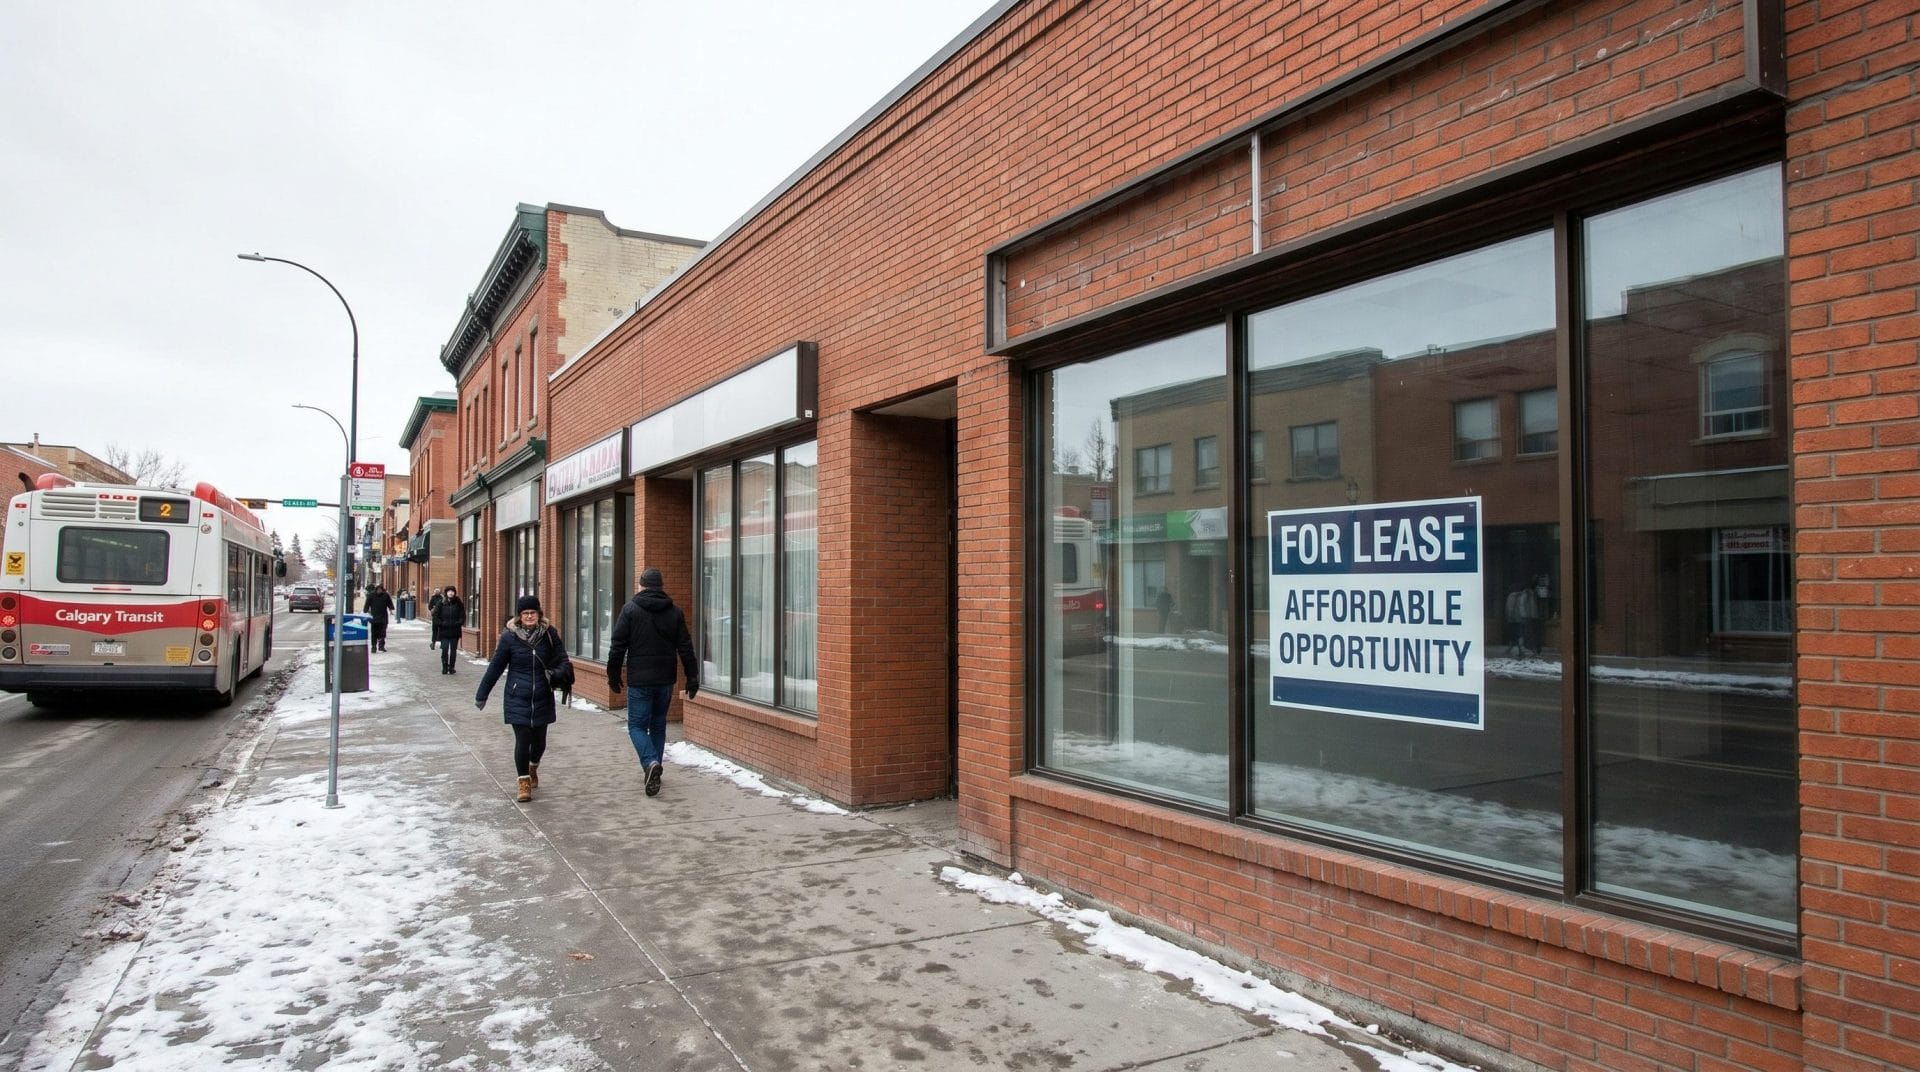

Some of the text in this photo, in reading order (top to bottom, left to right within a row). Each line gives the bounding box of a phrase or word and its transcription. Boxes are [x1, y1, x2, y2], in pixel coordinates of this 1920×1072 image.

[160, 503, 171, 517] 2
[1280, 515, 1466, 565] FOR LEASE
[55, 609, 164, 625] Calgary Transit
[1284, 589, 1462, 626] AFFORDABLE
[1279, 631, 1472, 677] OPPORTUNITY
